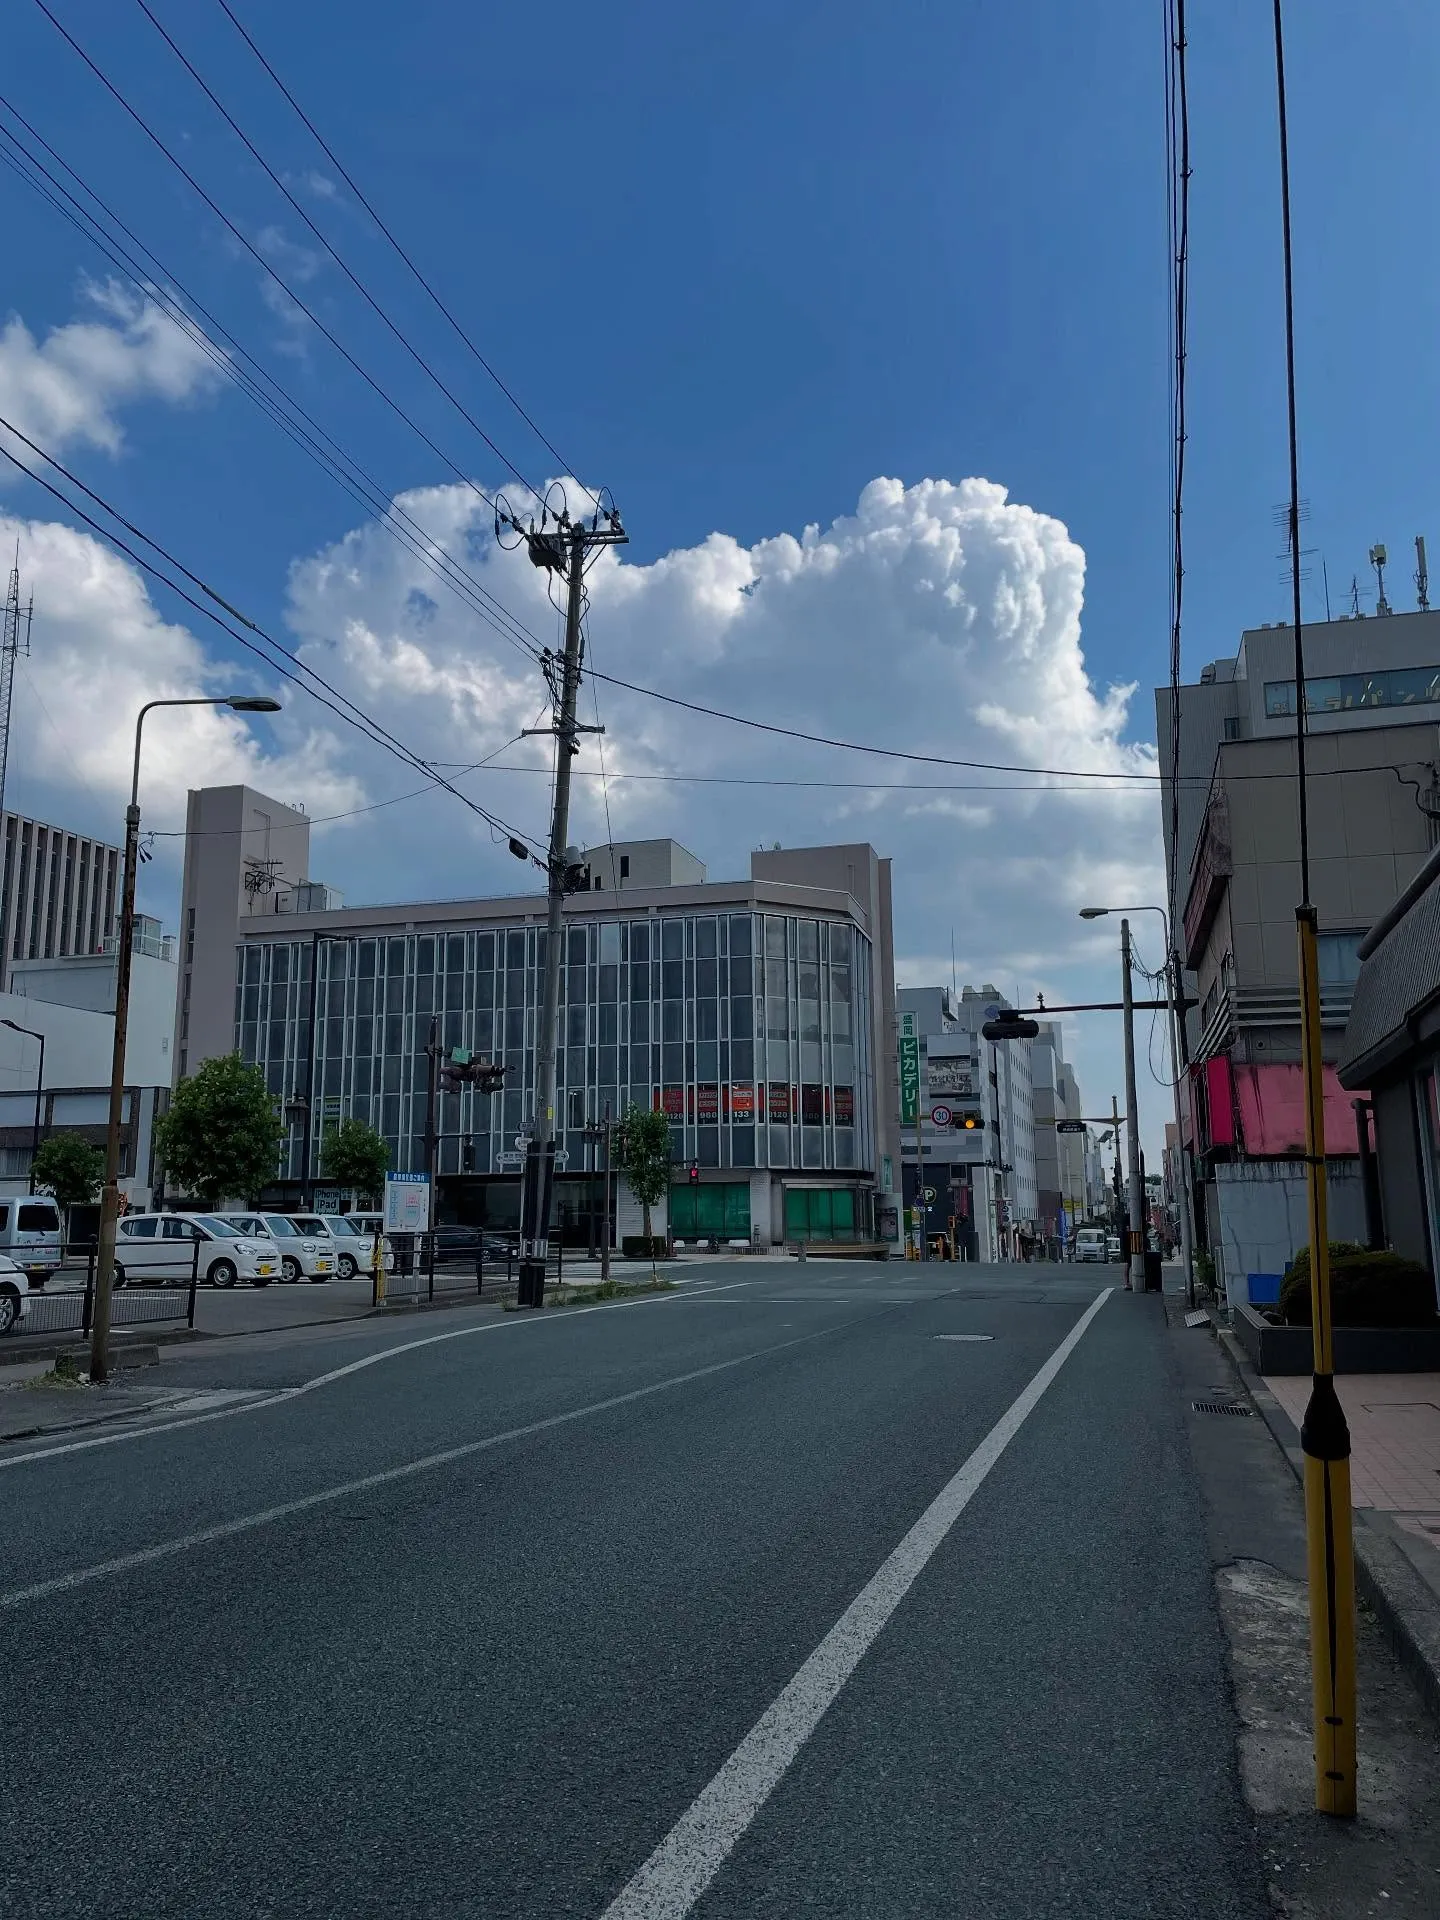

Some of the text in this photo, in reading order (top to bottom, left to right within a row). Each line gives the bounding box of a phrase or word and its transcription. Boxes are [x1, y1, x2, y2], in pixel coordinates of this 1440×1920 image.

[936, 1111, 948, 1121] 30
[315, 1190, 339, 1198] iPhone
[924, 1189, 934, 1201] P
[317, 1199, 337, 1208] iPad
